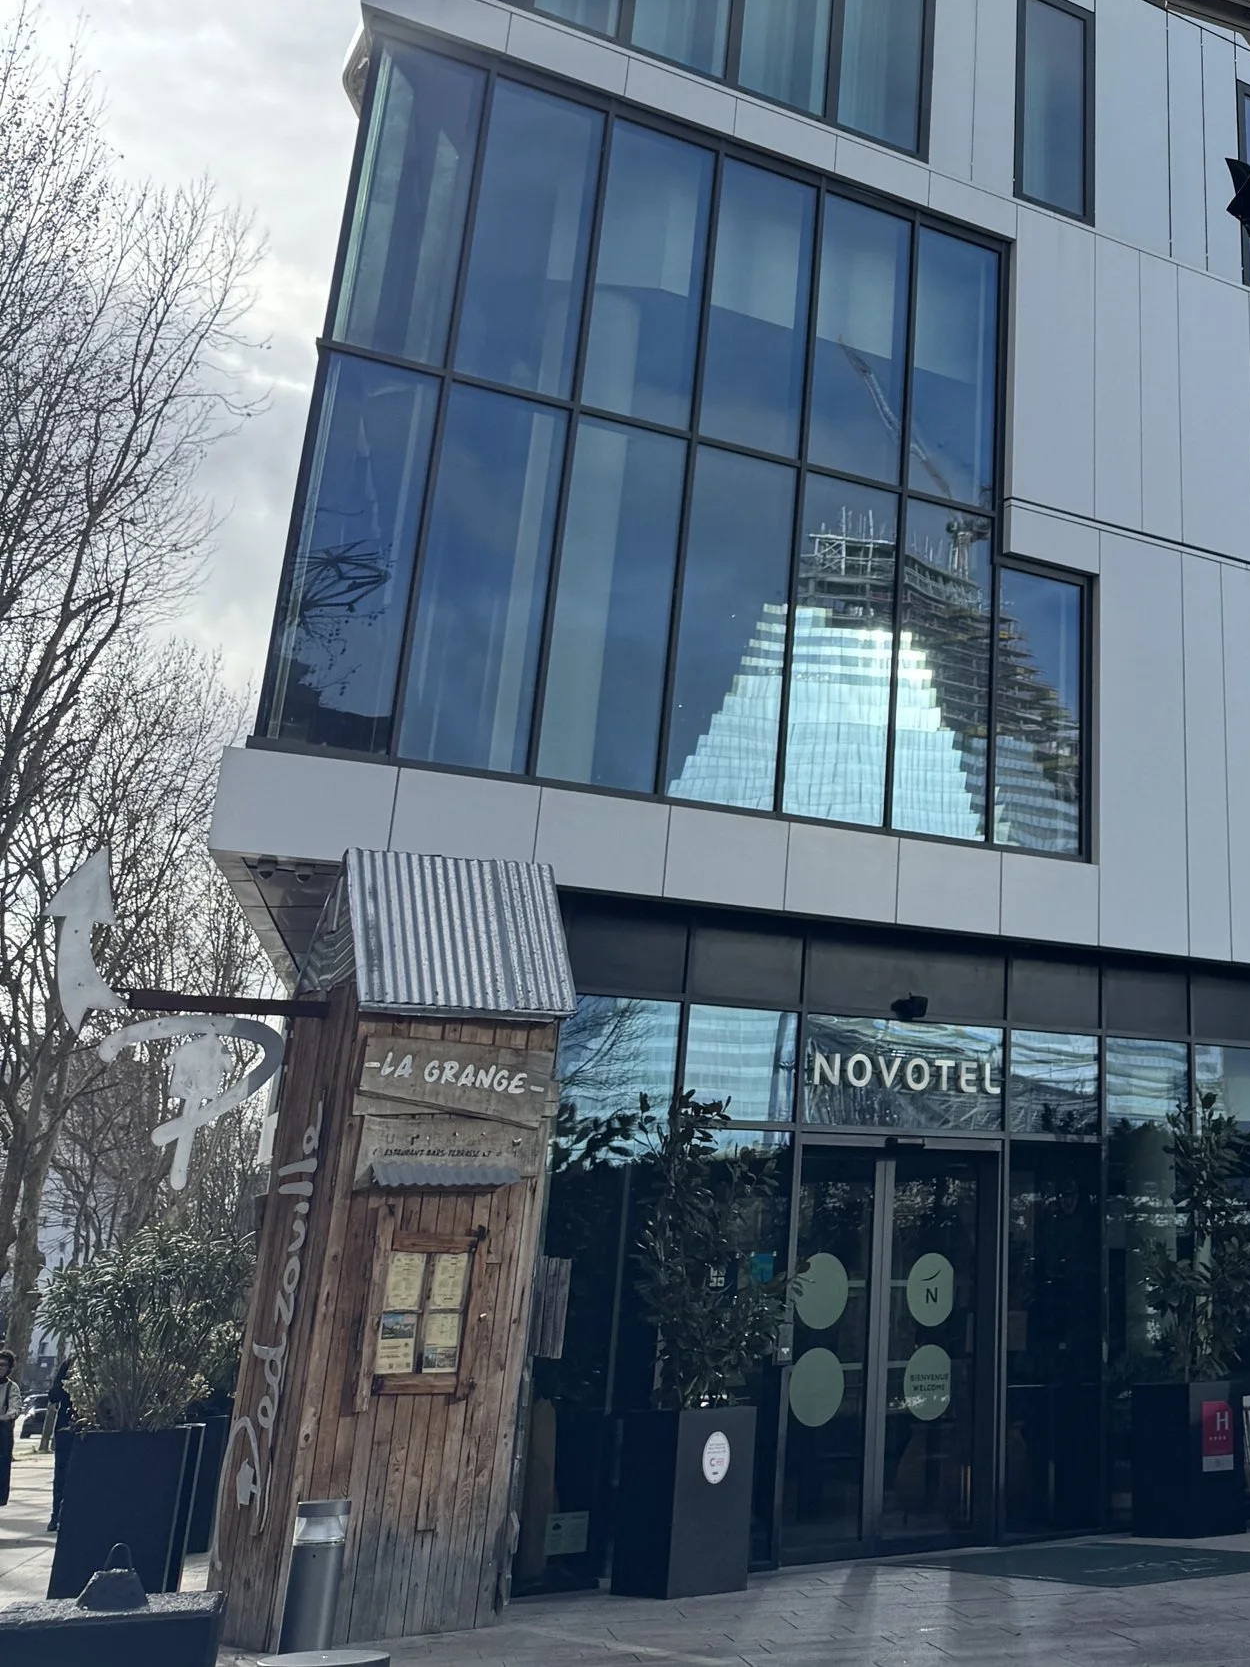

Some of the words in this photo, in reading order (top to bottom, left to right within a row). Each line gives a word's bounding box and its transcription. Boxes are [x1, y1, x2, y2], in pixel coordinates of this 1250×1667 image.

[813, 1052, 1001, 1095] NOVOTEL
[925, 1287, 938, 1304] N
[910, 1373, 949, 1382] BIENVENUE
[1216, 1410, 1229, 1431] H
